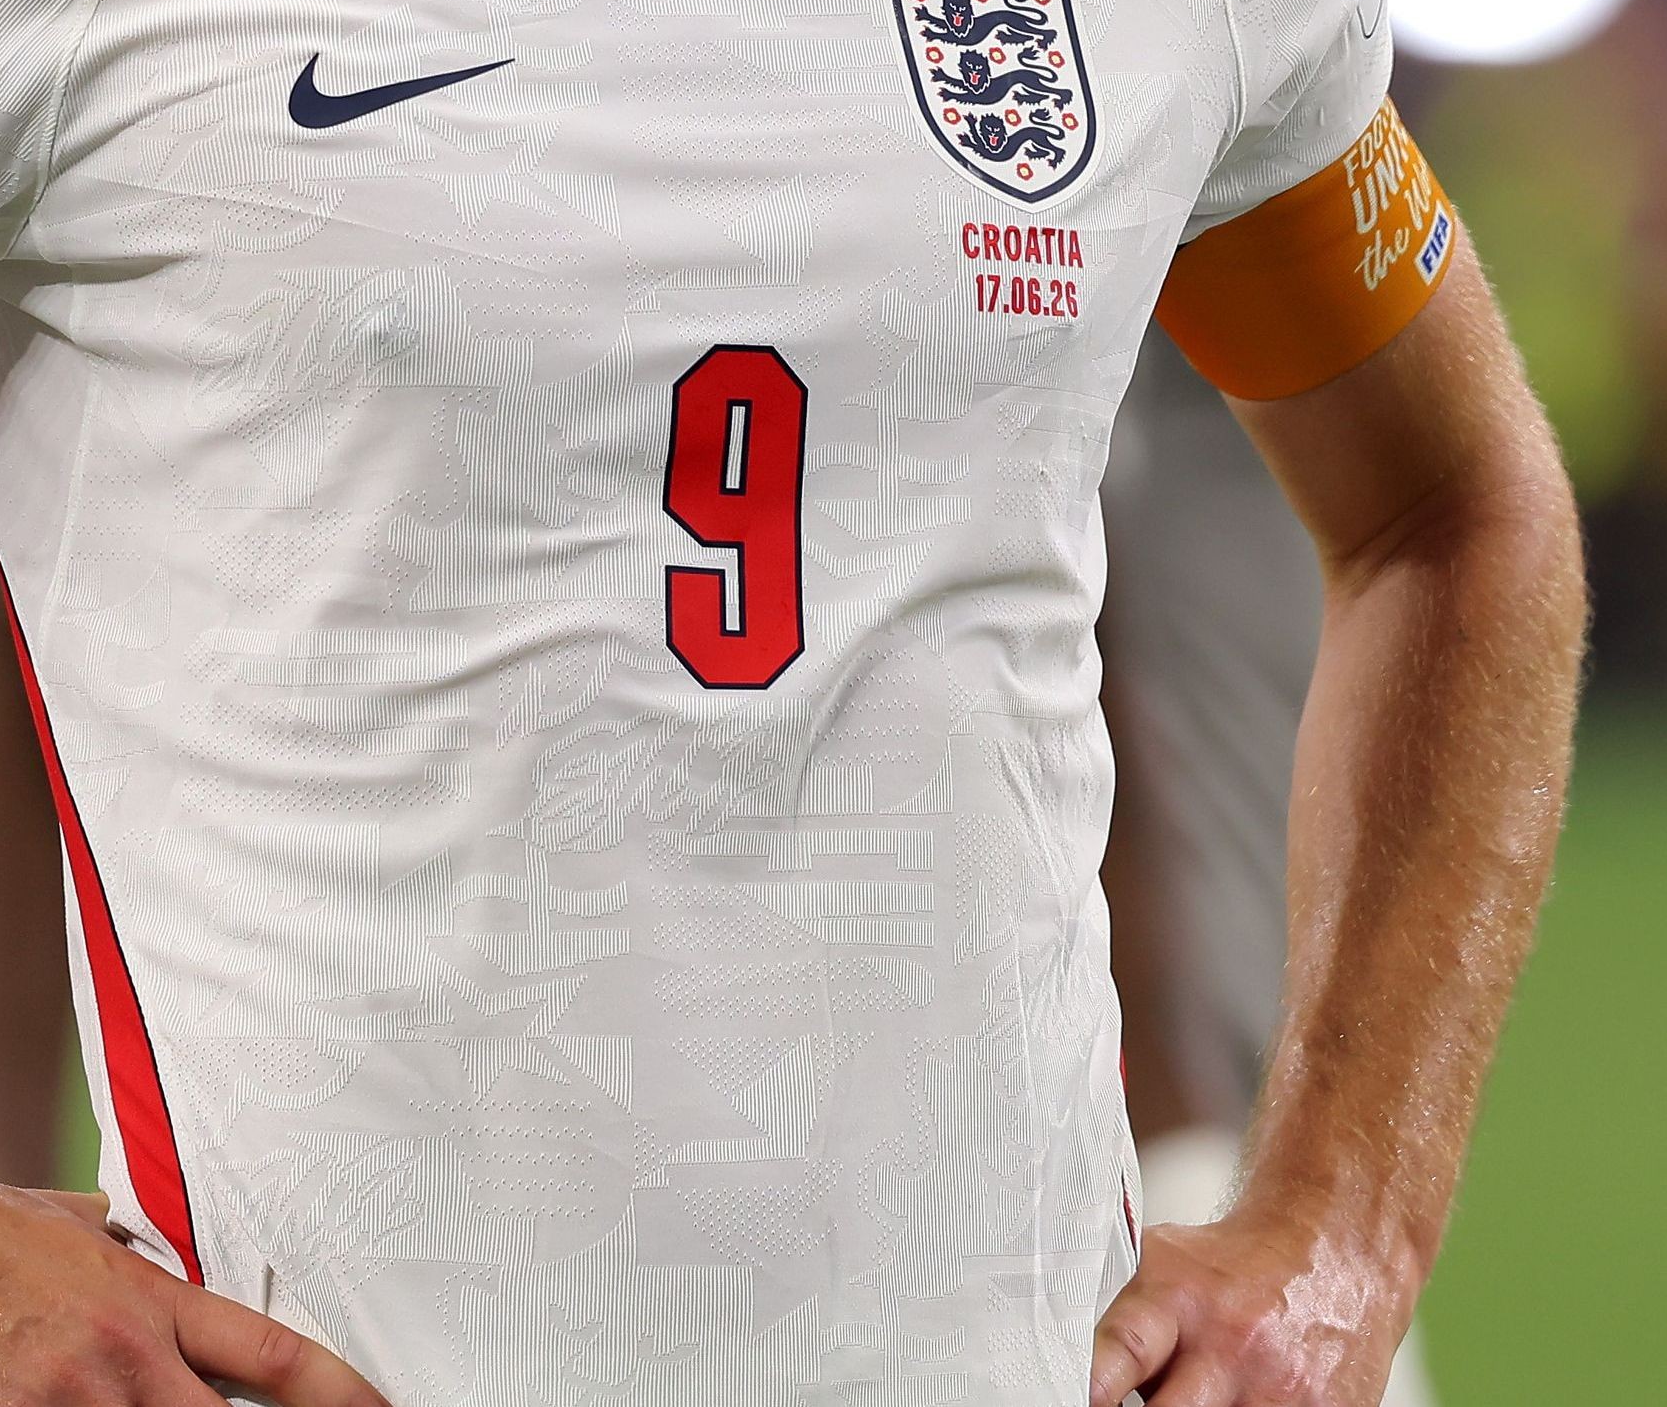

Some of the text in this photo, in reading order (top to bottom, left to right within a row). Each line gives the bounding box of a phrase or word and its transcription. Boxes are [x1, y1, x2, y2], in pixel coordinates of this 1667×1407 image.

[962, 222, 1083, 268] CROATIA
[1354, 226, 1410, 291] the
[1421, 213, 1449, 275] FIFA
[975, 273, 1078, 318] 17.06.26
[662, 344, 808, 690] 9
